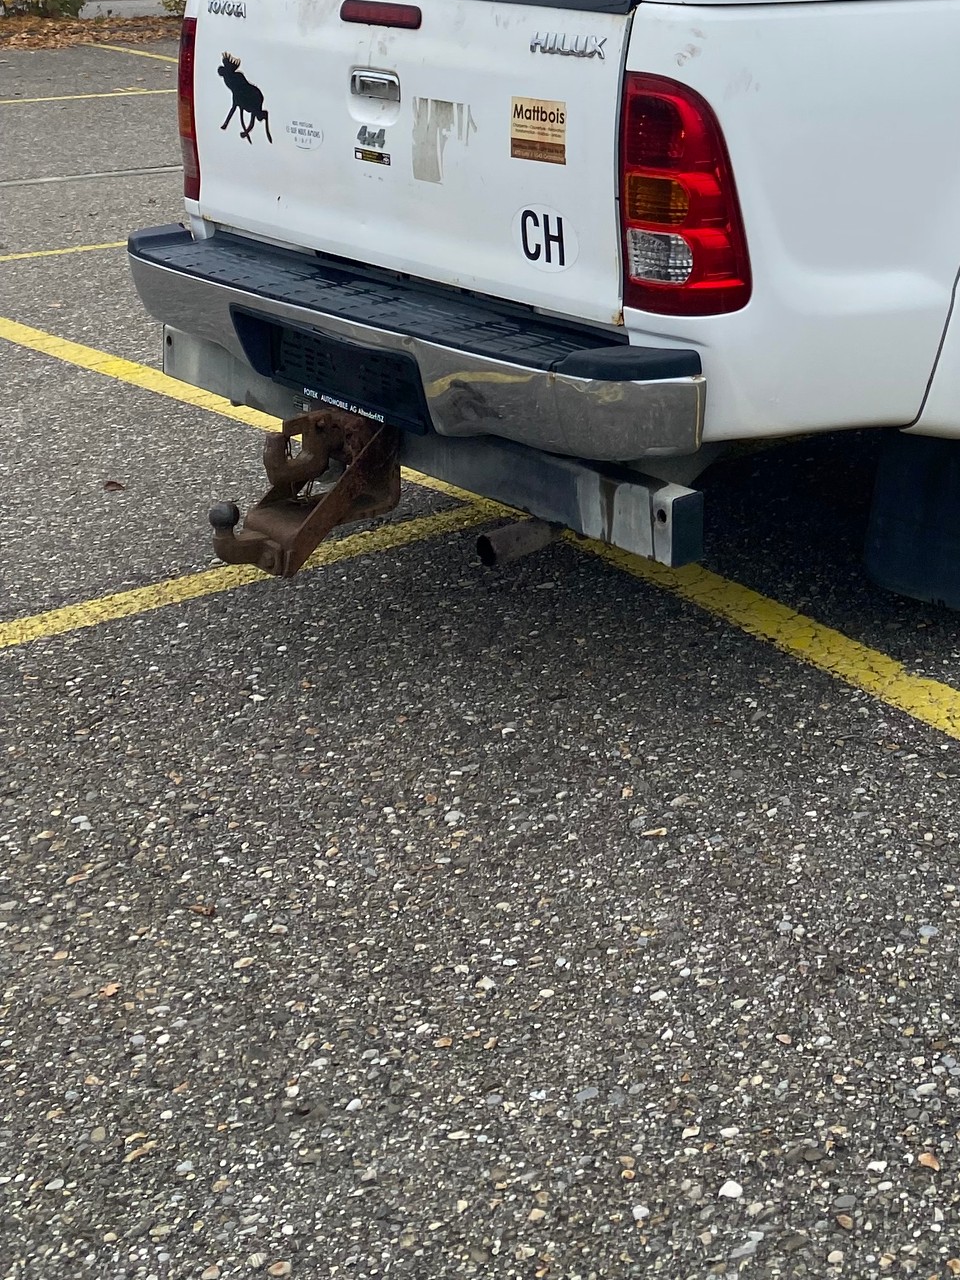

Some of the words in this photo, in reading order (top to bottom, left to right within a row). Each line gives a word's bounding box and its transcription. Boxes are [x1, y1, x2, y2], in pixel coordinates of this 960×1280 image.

[207, 0, 247, 19] TOYOTA
[530, 31, 608, 60] HILUX
[513, 103, 565, 125] Mattbois
[356, 125, 386, 148] 4x4
[520, 209, 566, 266] CH
[320, 394, 348, 410] AUTOMOBILE
[349, 405, 358, 414] AG
